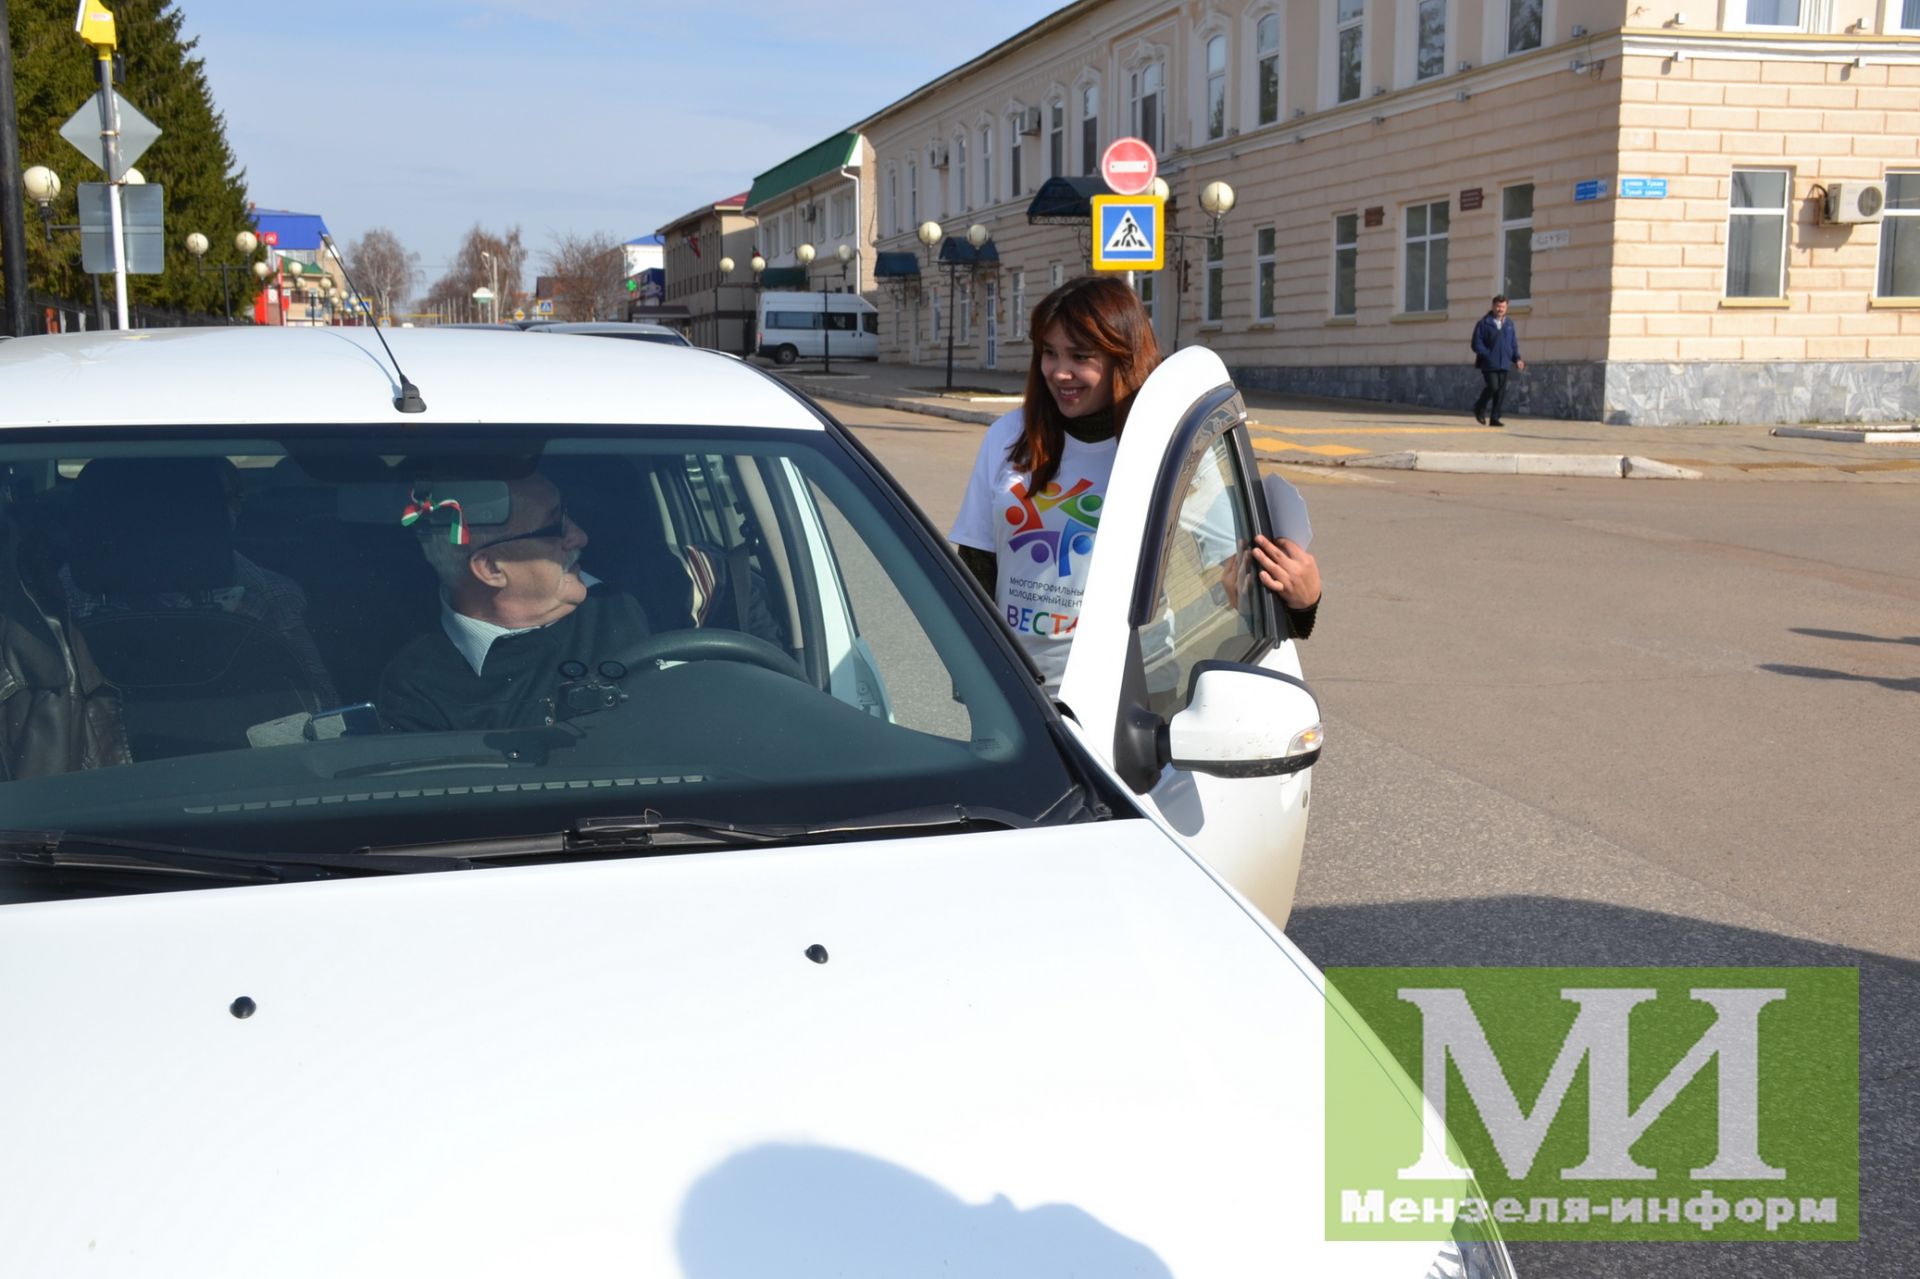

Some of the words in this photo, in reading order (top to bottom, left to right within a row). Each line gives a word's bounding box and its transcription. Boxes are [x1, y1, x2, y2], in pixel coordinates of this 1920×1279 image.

[1010, 577, 1084, 596] МНОГОПРОФИЛЬНЫ
[1009, 588, 1061, 605] МОЛОДЕЖНЫЙ
[1061, 600, 1083, 608] ЦЕНТ
